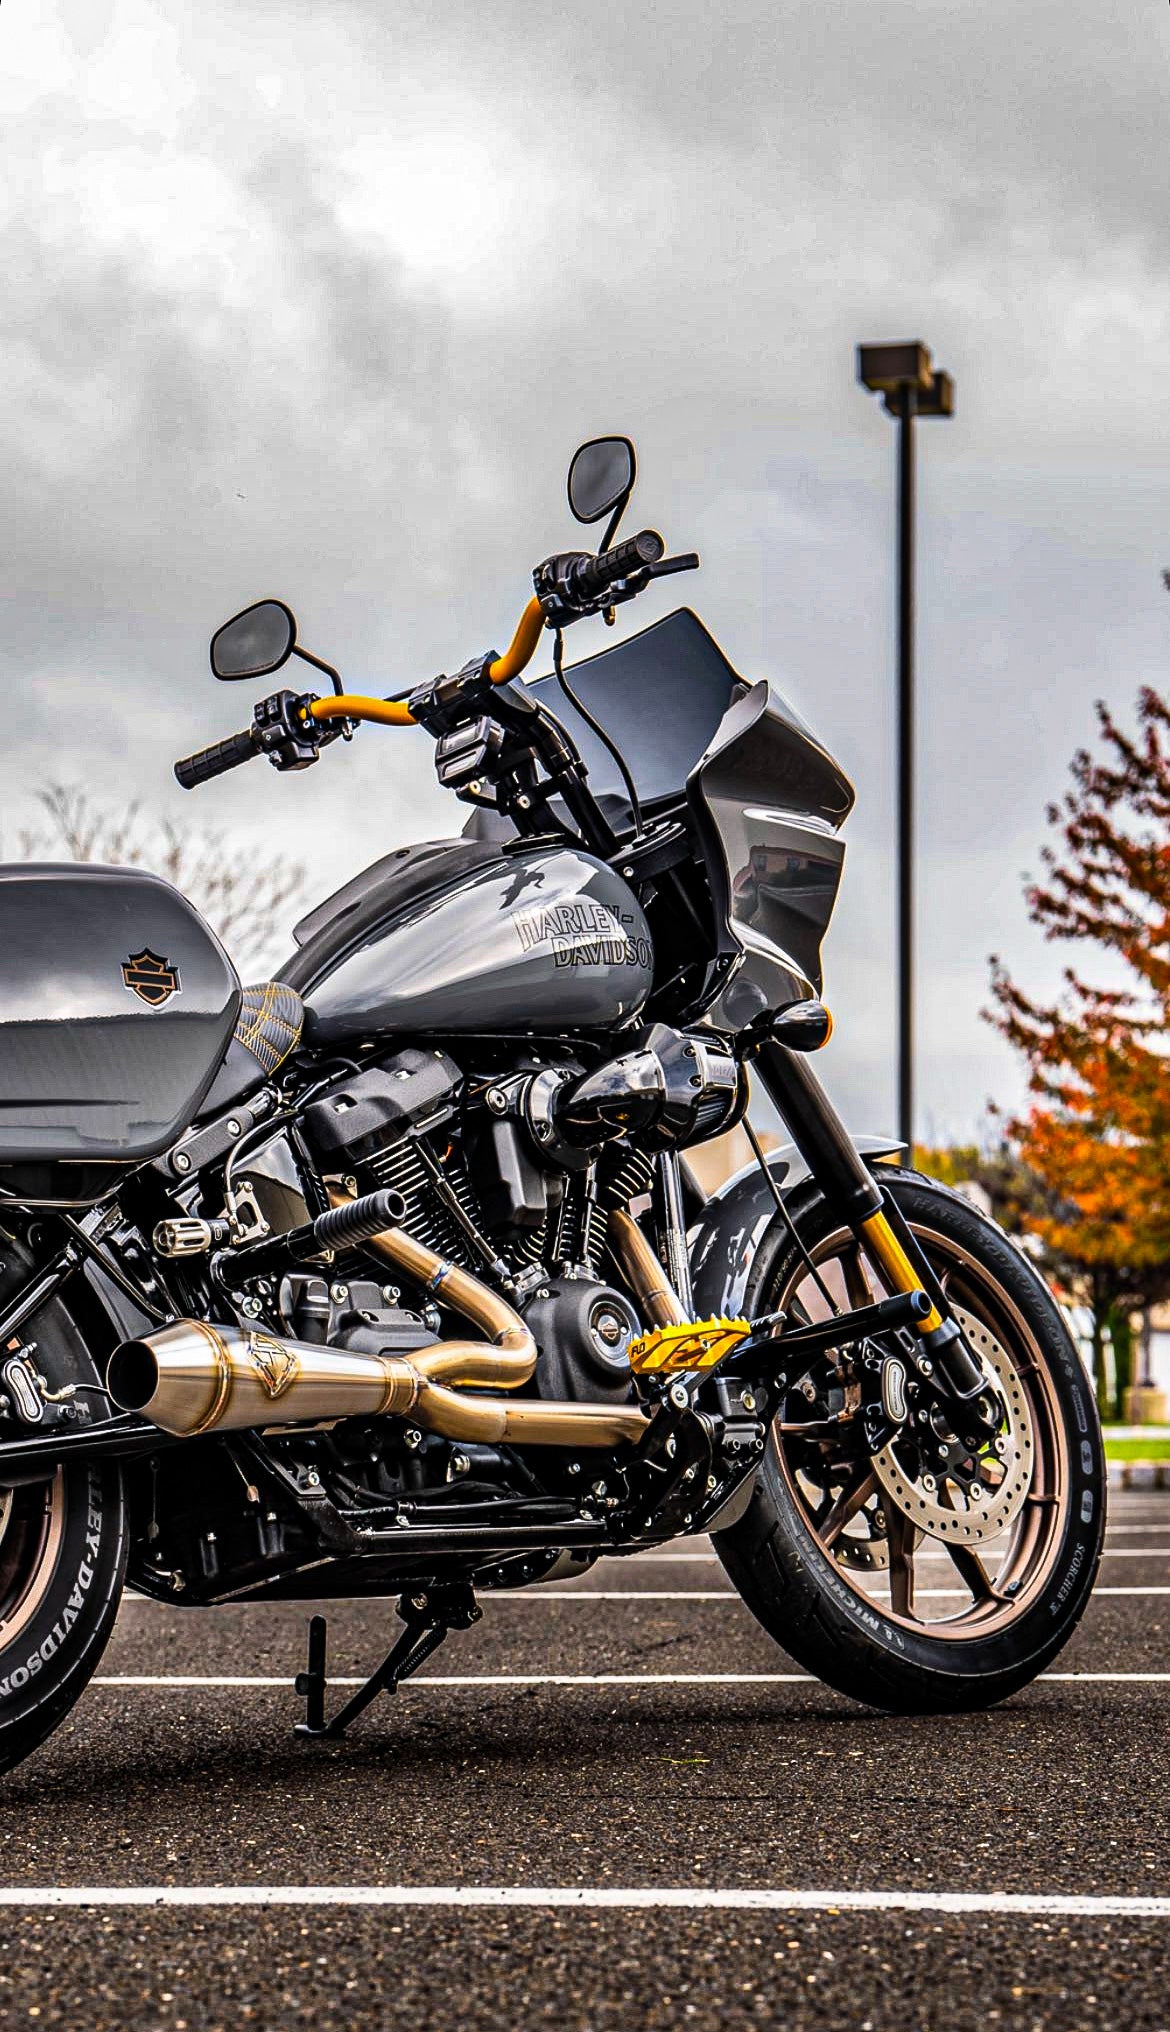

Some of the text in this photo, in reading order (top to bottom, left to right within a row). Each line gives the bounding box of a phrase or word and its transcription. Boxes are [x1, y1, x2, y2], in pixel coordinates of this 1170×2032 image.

[512, 904, 634, 953] HARLEY-
[551, 935, 653, 970] DAVIDSO
[1056, 1542, 1086, 1602] SCORCHER
